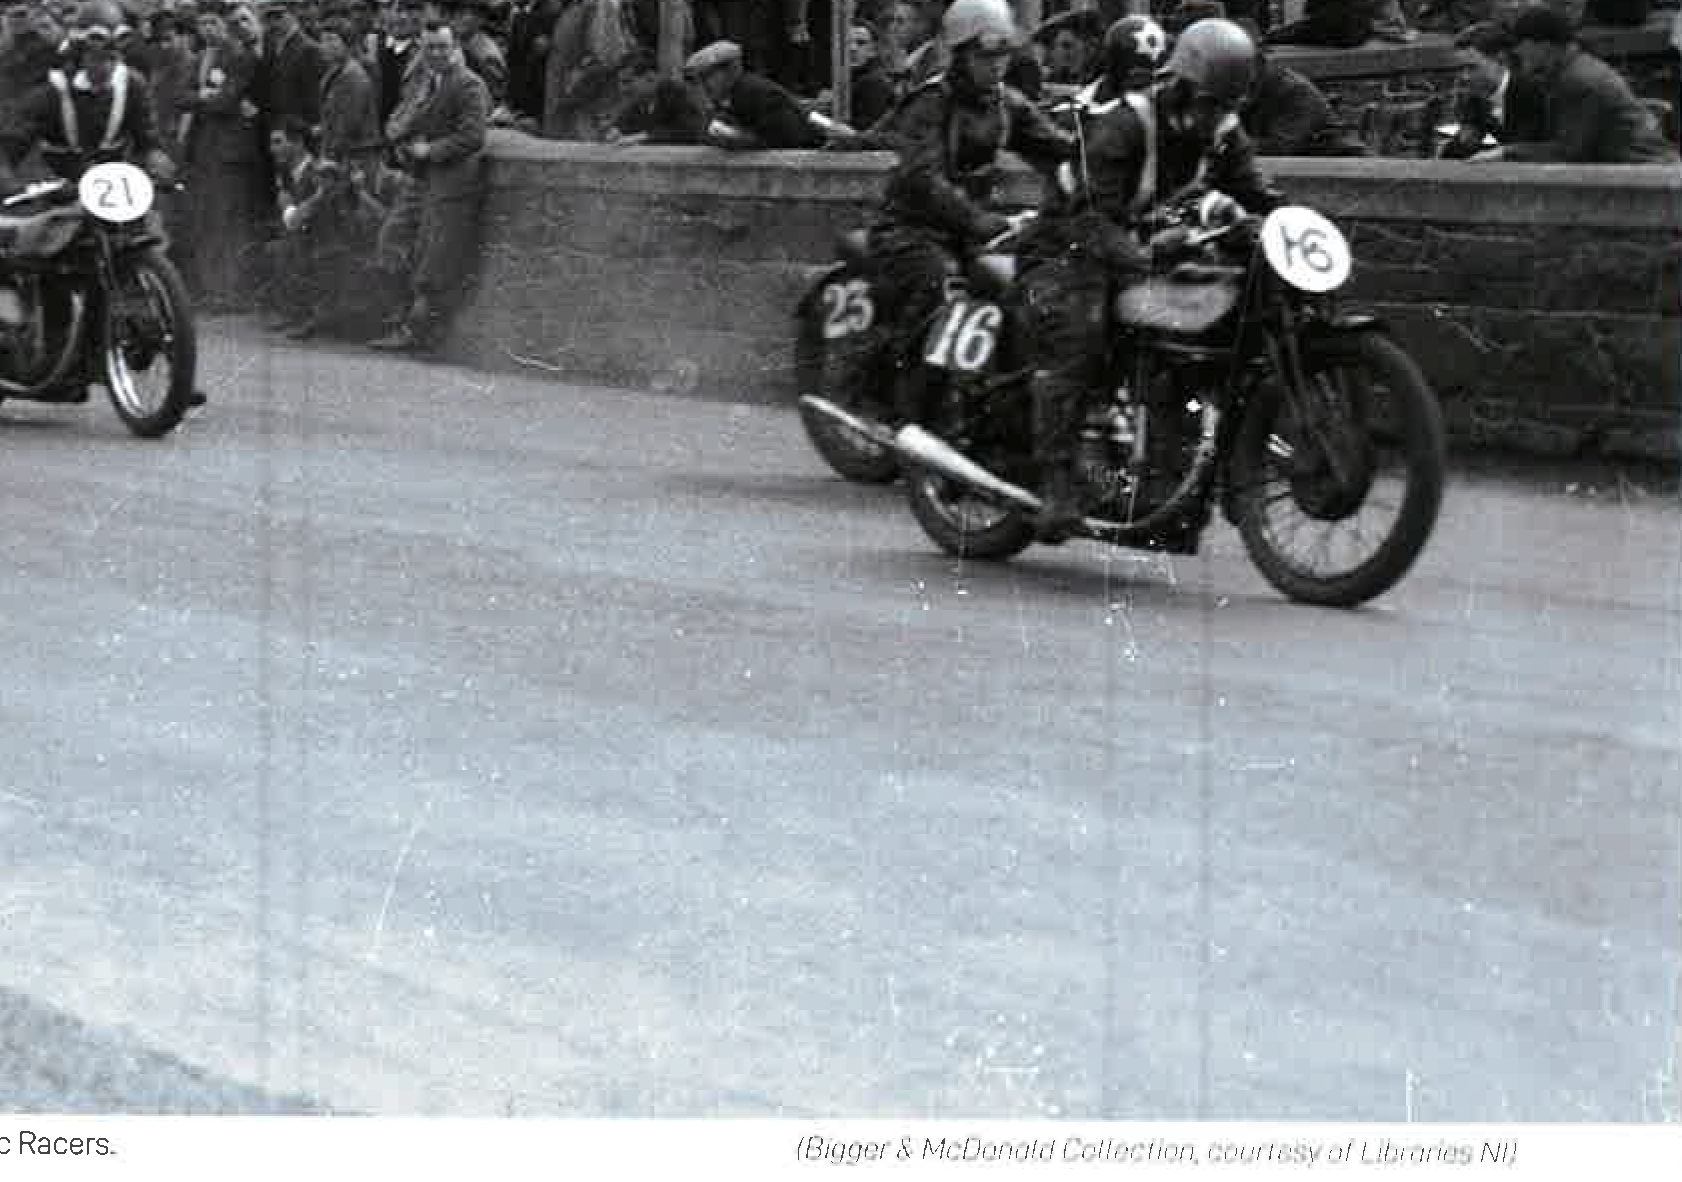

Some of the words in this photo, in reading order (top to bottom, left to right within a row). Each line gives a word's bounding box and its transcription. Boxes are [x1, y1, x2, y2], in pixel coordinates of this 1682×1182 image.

[93, 177, 134, 208] 21
[1279, 225, 1334, 274] 16
[924, 301, 1004, 371] 16
